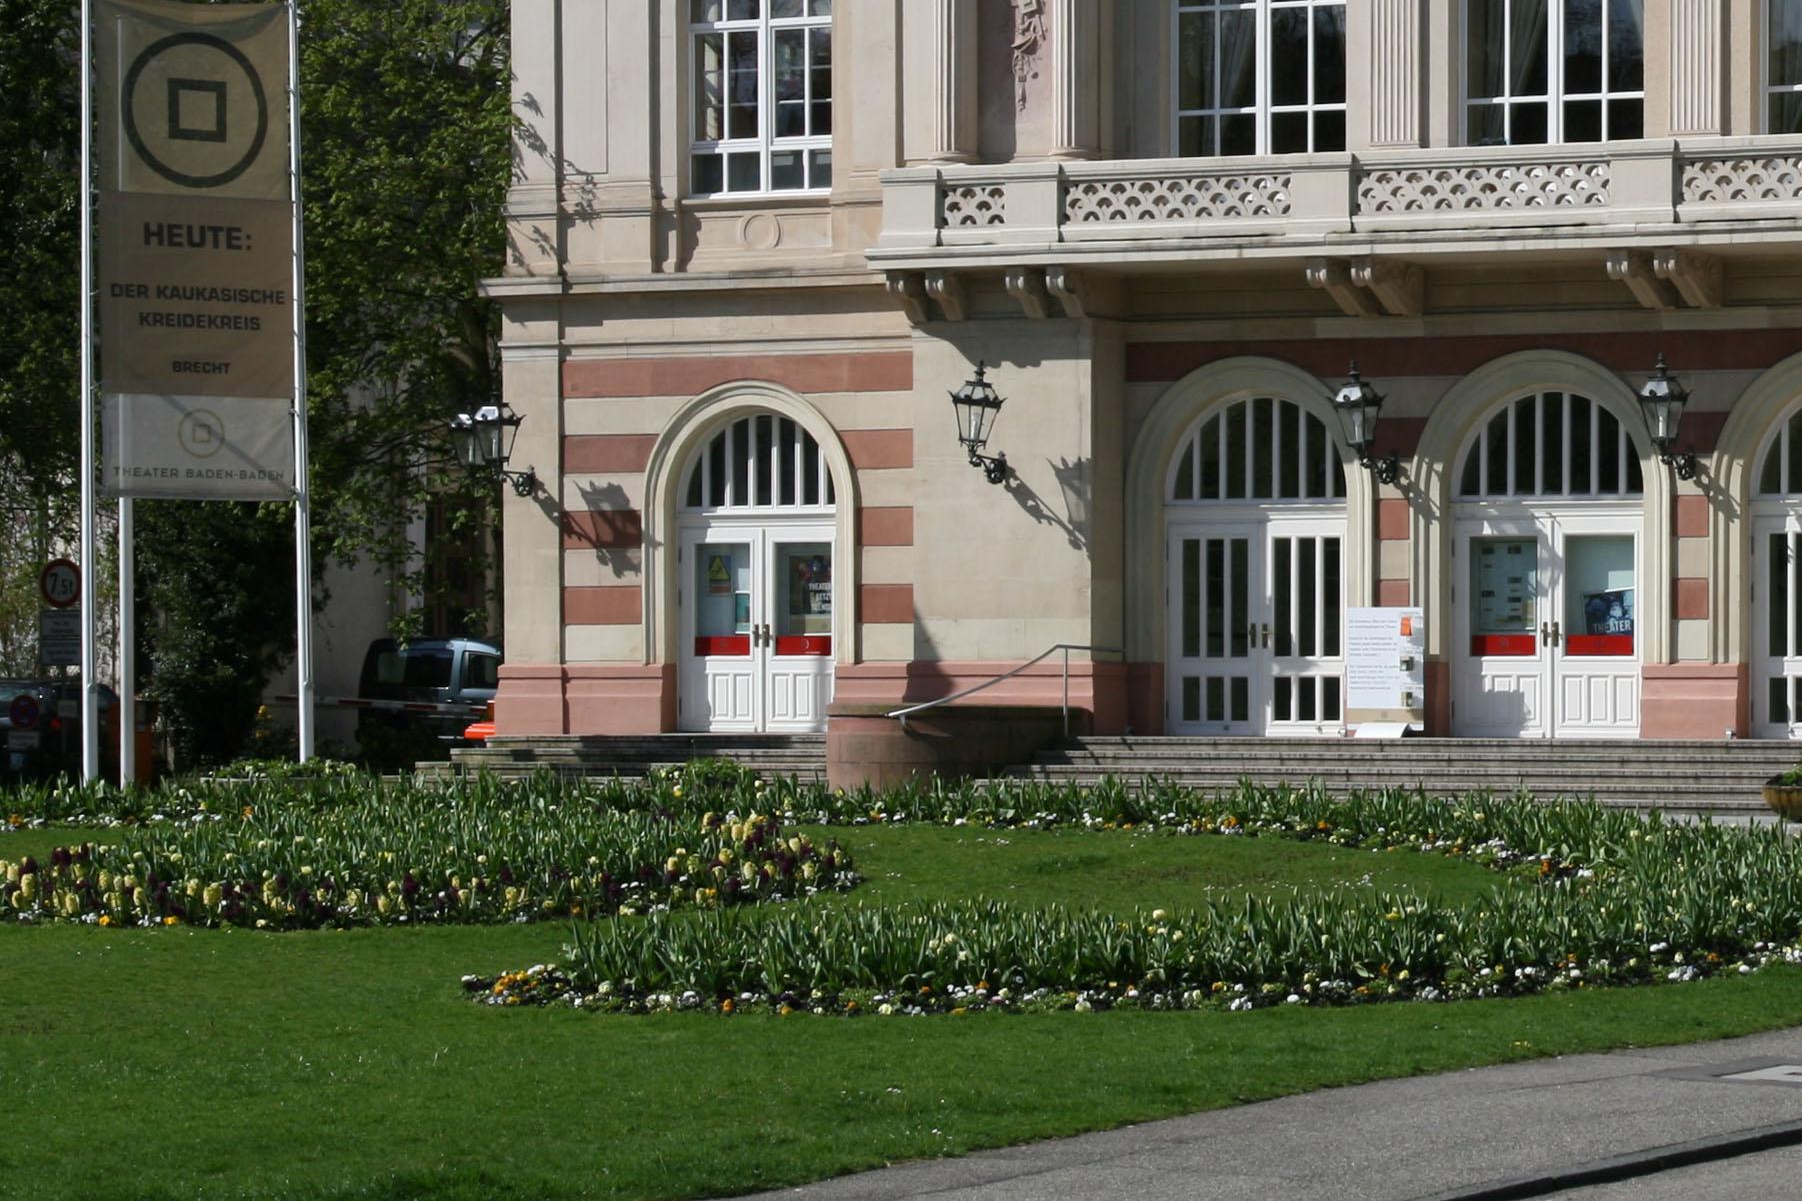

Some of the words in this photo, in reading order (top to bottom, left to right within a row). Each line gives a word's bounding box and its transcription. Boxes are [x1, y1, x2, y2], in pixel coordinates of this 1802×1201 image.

[144, 222, 252, 251] HEUTE:
[111, 283, 149, 299] DER
[156, 285, 286, 305] KAUKASISCHE
[139, 312, 261, 331] KREIDEKREIS
[172, 360, 231, 374] BRECHT
[113, 466, 179, 479] THEATER
[186, 468, 284, 481] BADEN-BADEN
[1592, 619, 1632, 633] THEATER
